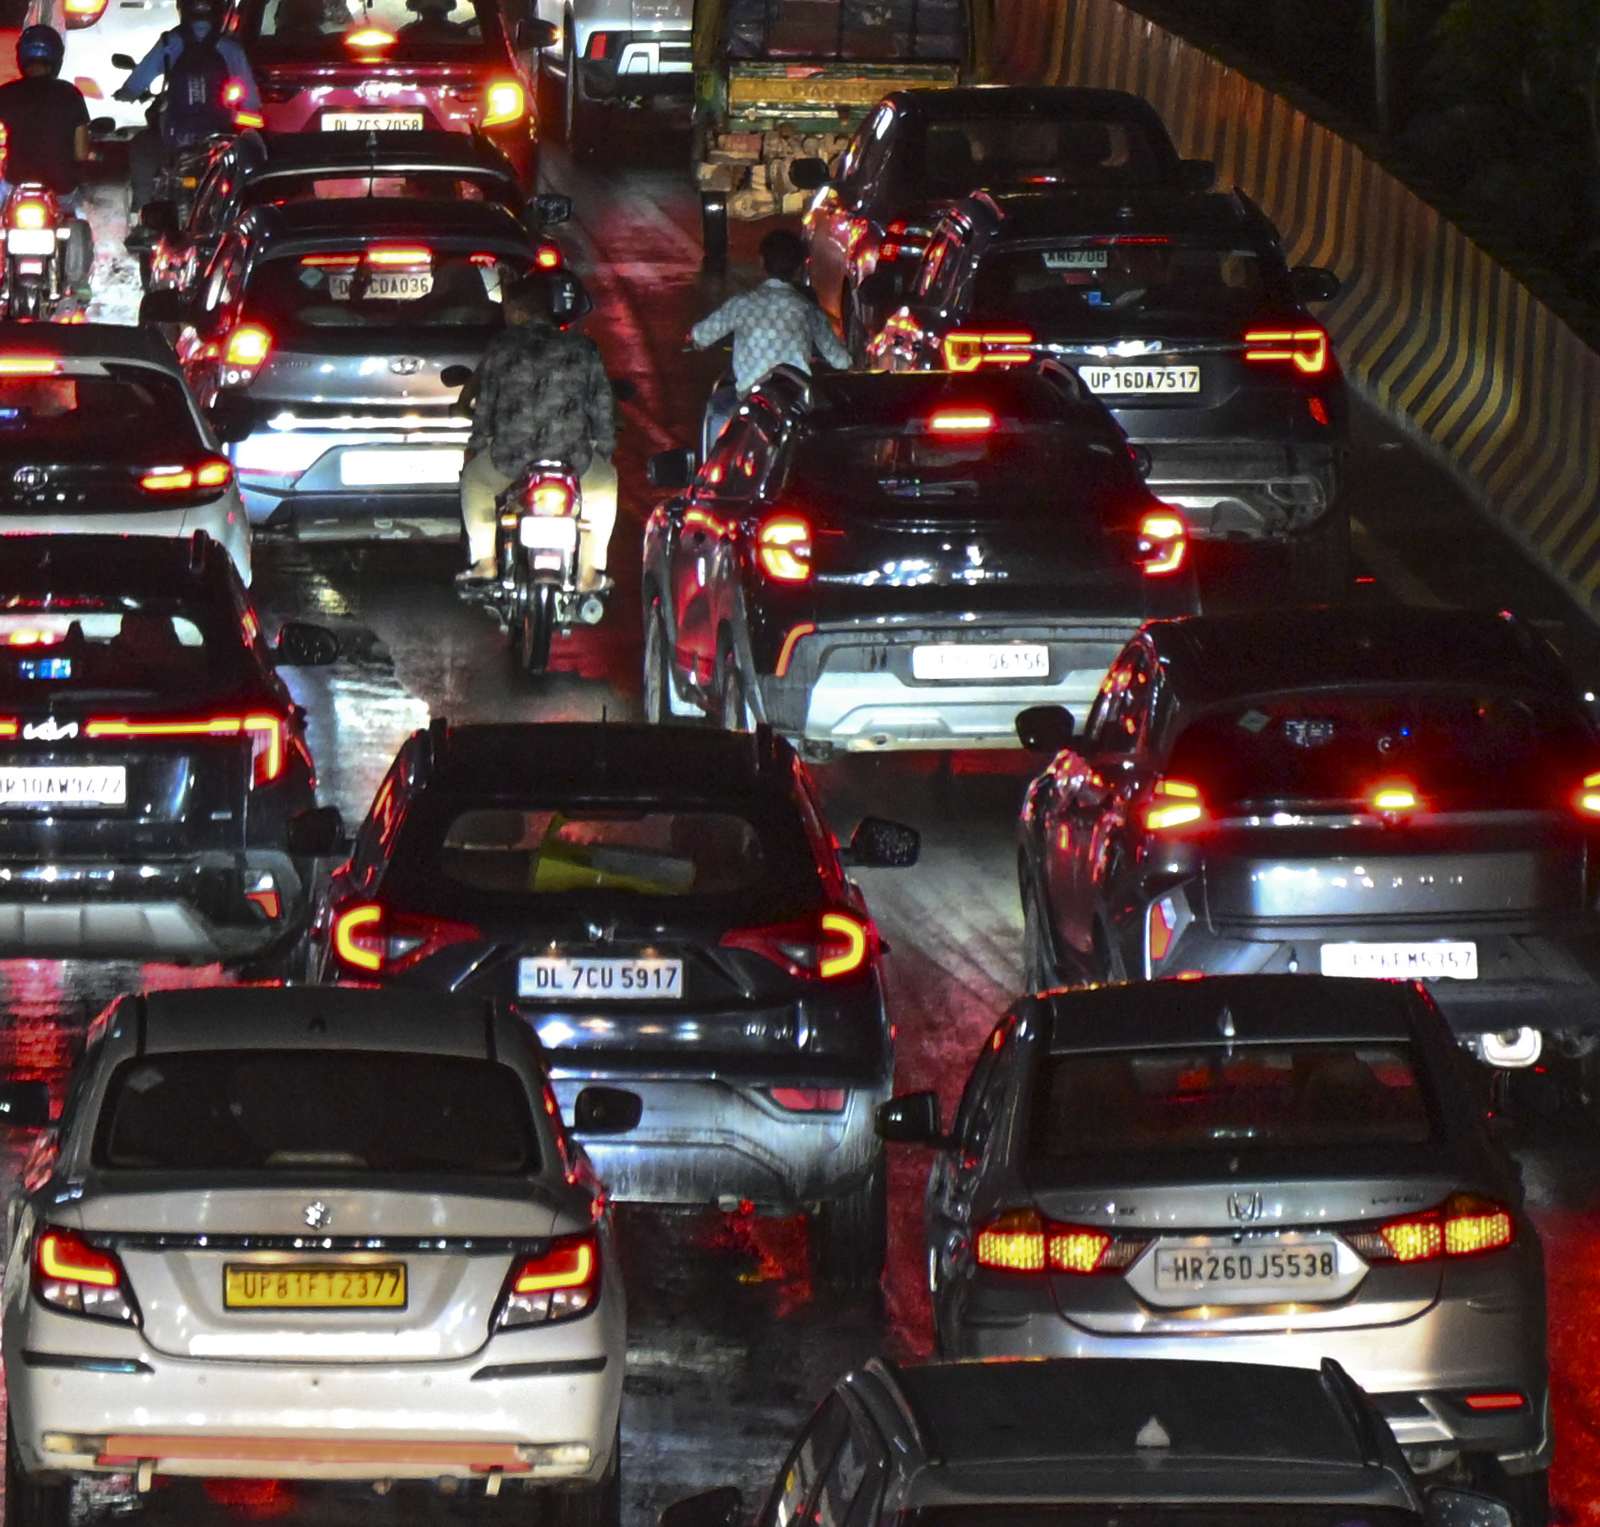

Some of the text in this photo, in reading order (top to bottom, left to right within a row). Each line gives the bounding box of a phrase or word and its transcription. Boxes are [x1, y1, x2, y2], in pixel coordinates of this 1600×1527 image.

[1090, 373, 1199, 389] UP16DA7517
[536, 966, 678, 990] DL 7CU 5917
[1173, 1252, 1334, 1283] HR26DJ5538
[242, 1272, 400, 1300] UP81FT2377
